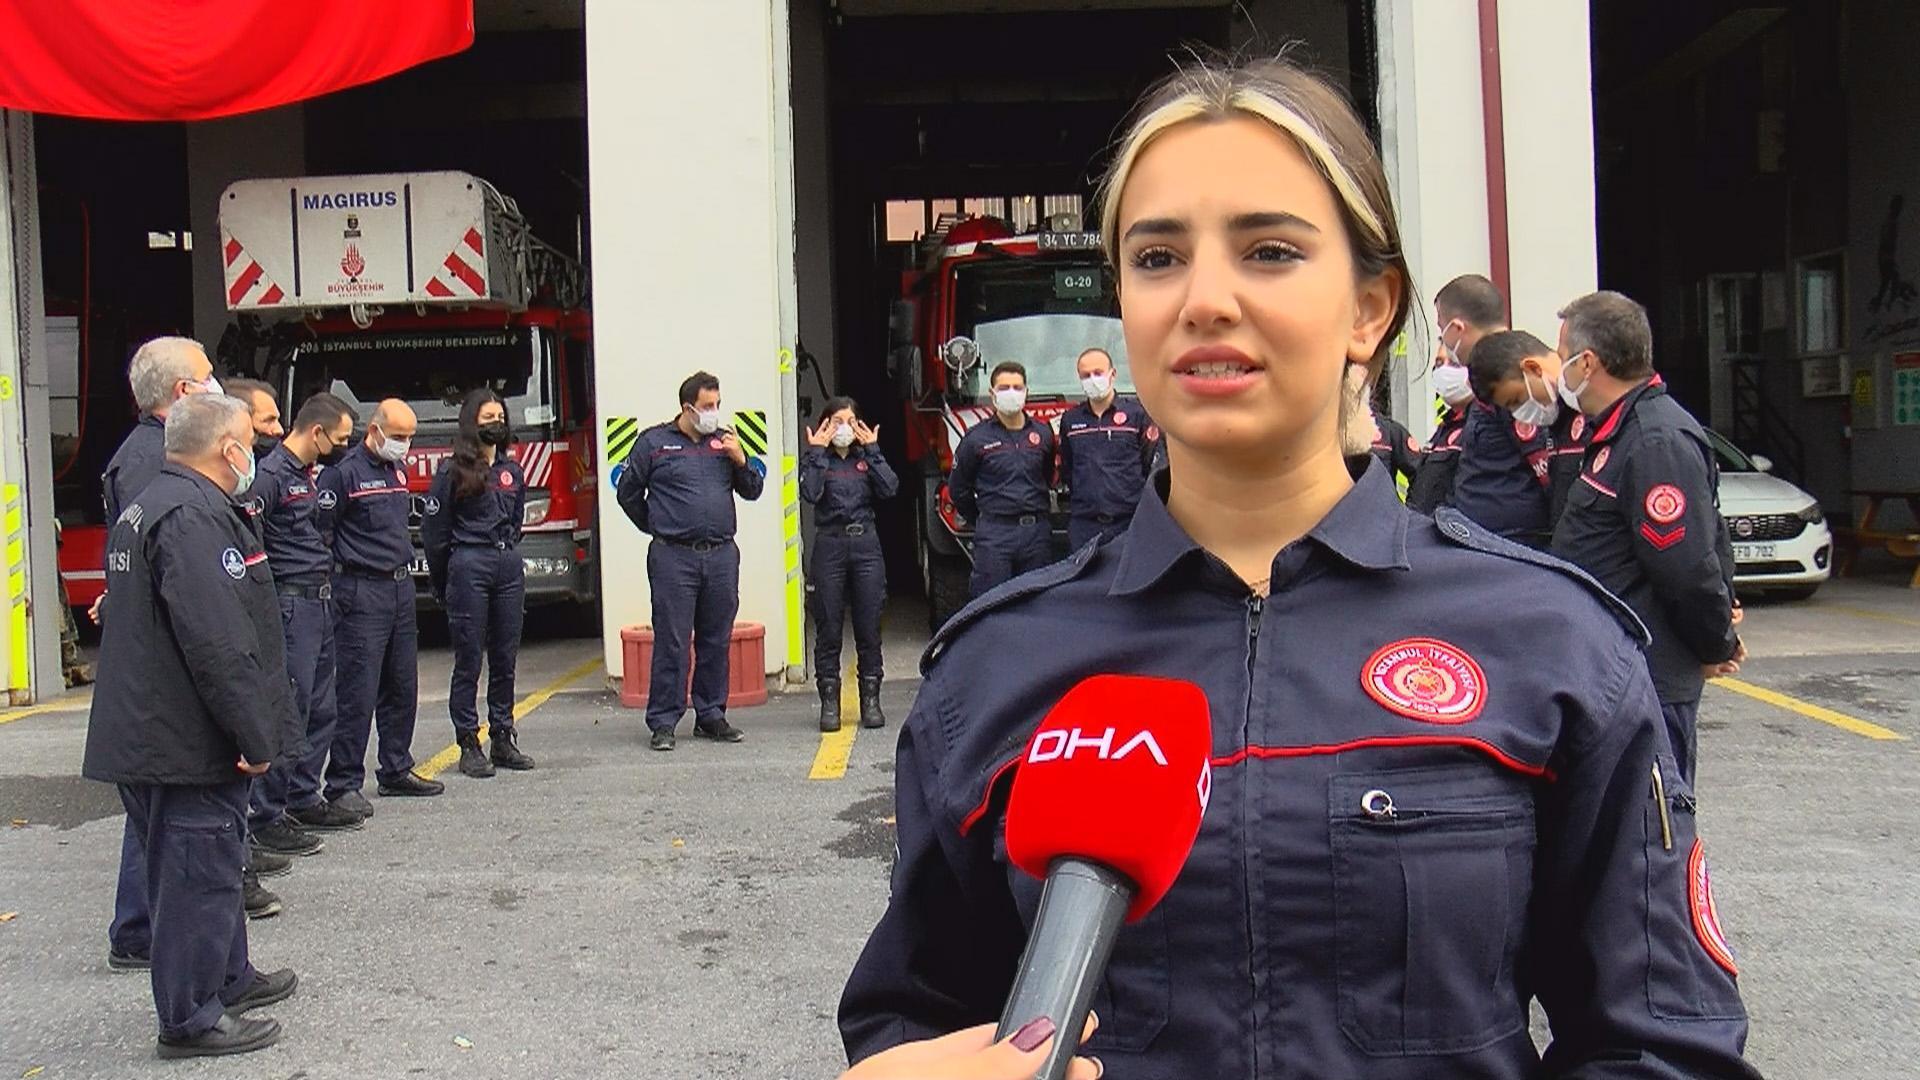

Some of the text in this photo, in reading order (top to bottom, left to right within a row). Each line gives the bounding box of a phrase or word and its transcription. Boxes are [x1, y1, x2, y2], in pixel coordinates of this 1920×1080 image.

[303, 191, 397, 210] MAGIRUS
[1044, 234, 1057, 247] 34
[1063, 234, 1077, 246] YC
[1064, 275, 1092, 288] G-20
[779, 349, 793, 374] 2
[1028, 727, 1169, 766] DHA
